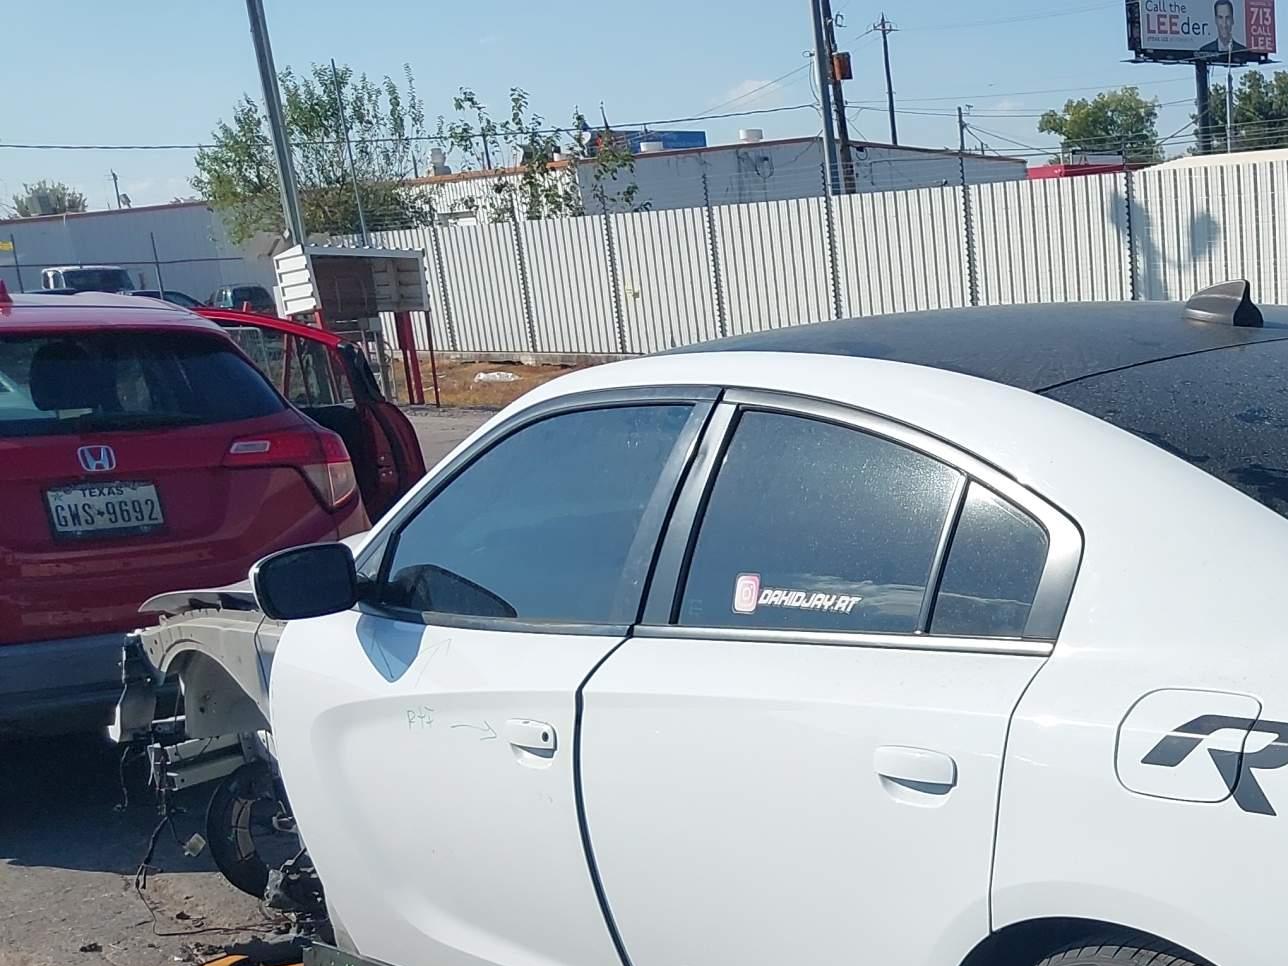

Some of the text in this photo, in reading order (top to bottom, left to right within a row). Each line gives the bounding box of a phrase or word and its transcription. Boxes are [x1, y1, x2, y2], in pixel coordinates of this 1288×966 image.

[1145, 0, 1187, 14] Call the
[1250, 8, 1272, 26] 713
[1146, 13, 1211, 36] LEEder.
[1250, 25, 1272, 36] CALL
[1250, 36, 1273, 51] LEE
[81, 486, 124, 498] TEXAS
